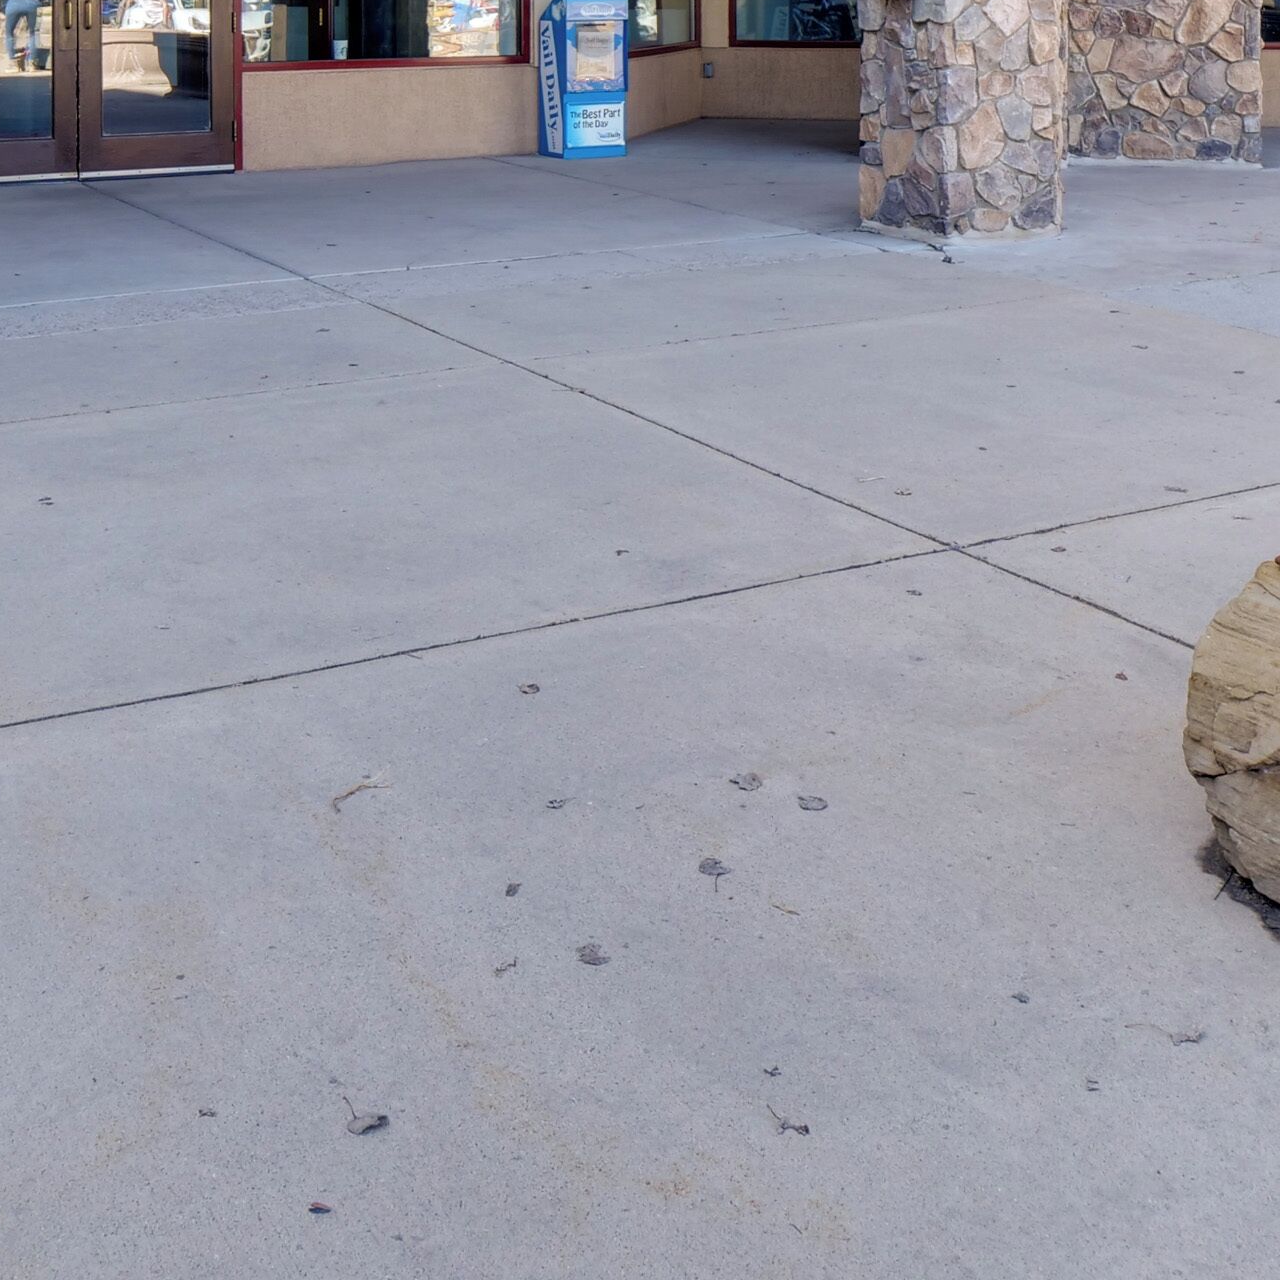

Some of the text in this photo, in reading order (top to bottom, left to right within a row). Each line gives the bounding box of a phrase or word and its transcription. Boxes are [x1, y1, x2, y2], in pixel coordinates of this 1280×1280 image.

[541, 23, 554, 67] Vail
[546, 74, 559, 130] Daily
[582, 109, 601, 119] Best
[603, 108, 621, 118] Part
[573, 120, 608, 129] of the Day
